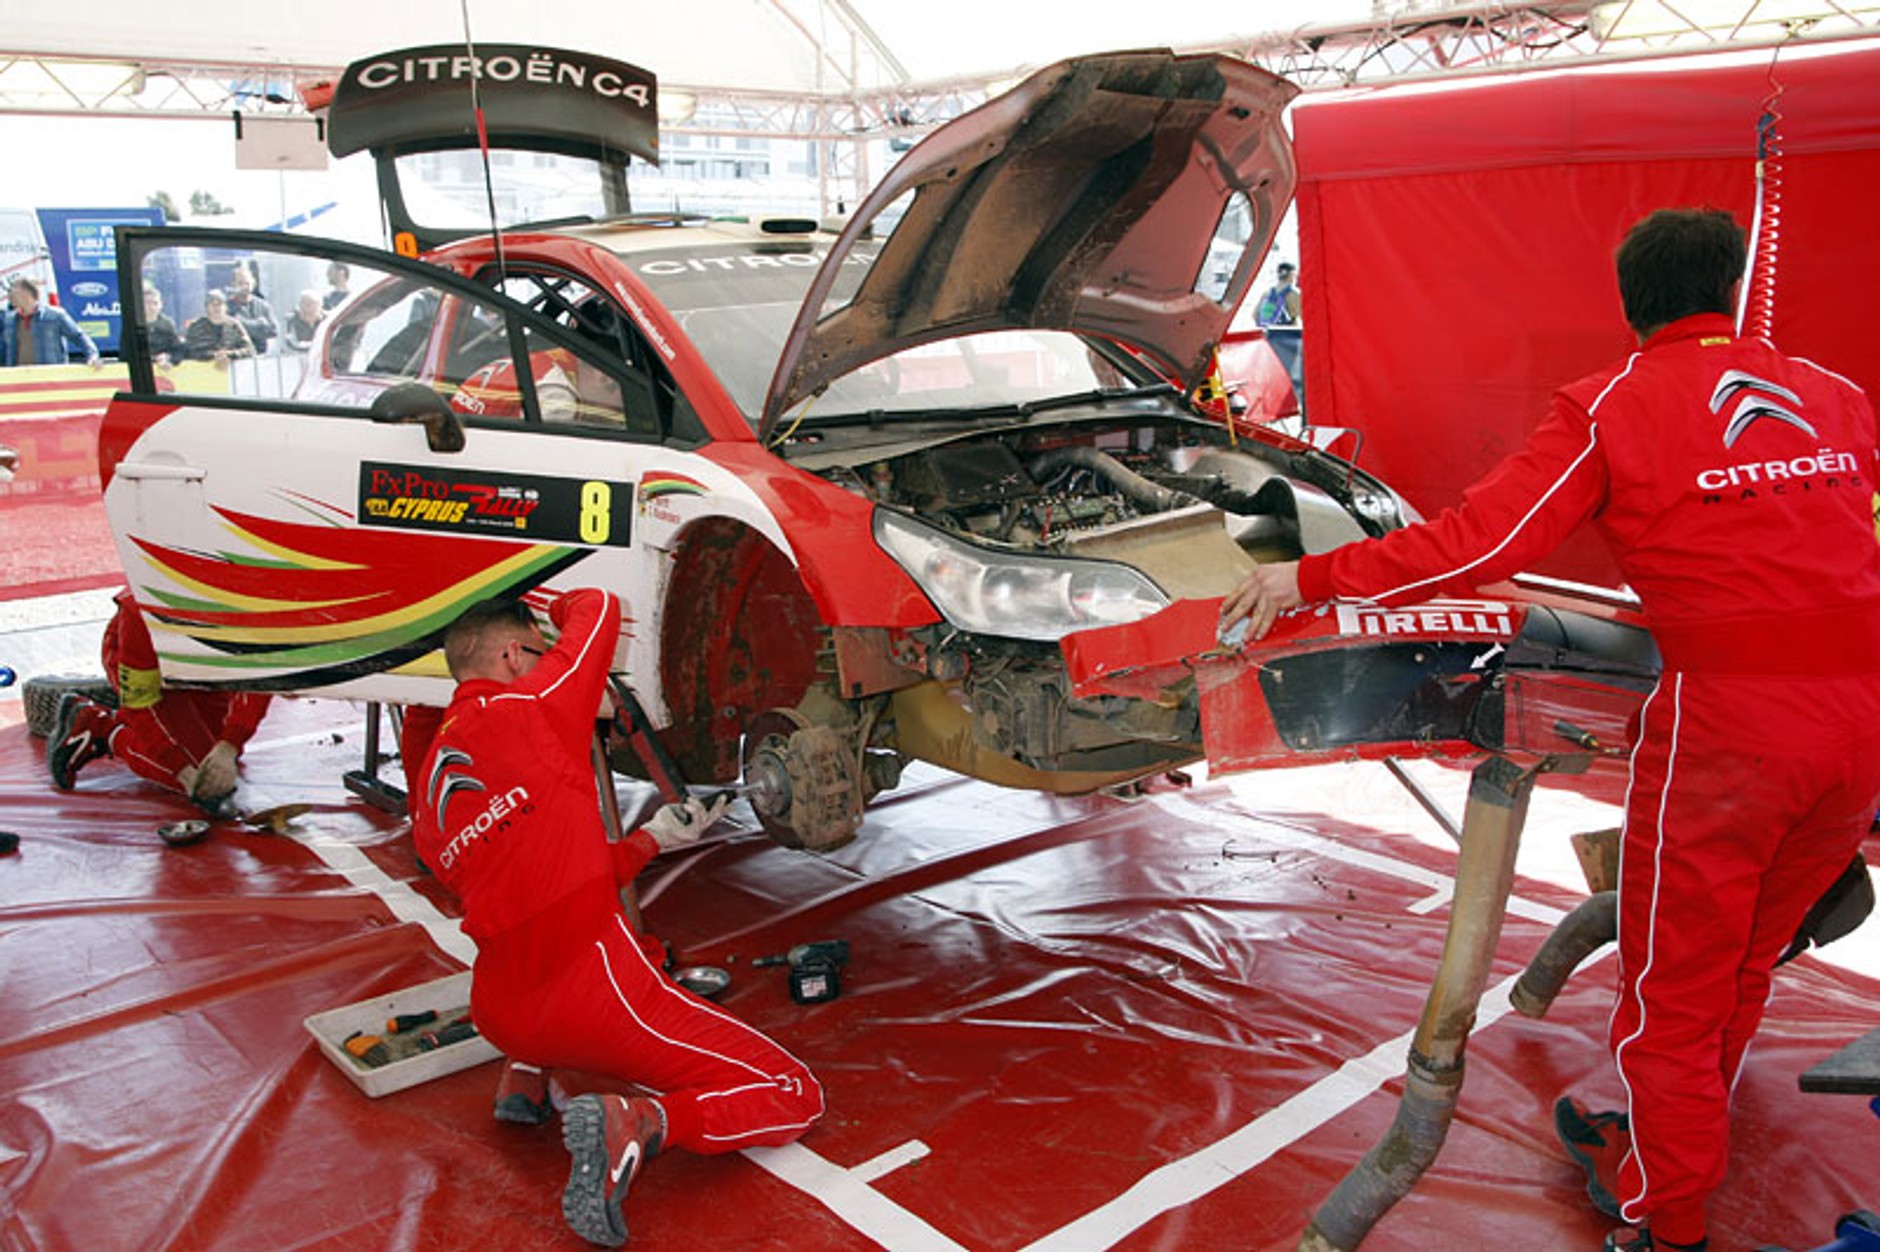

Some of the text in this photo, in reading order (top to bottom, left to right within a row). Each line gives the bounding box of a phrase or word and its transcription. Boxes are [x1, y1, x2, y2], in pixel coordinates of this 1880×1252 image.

[357, 53, 650, 108] CITROËN C4
[371, 469, 449, 499] FxPro
[452, 483, 540, 517] RALLY
[389, 497, 469, 523] CYPRUS
[579, 480, 612, 544] 8
[1336, 598, 1513, 636] PIRELLI
